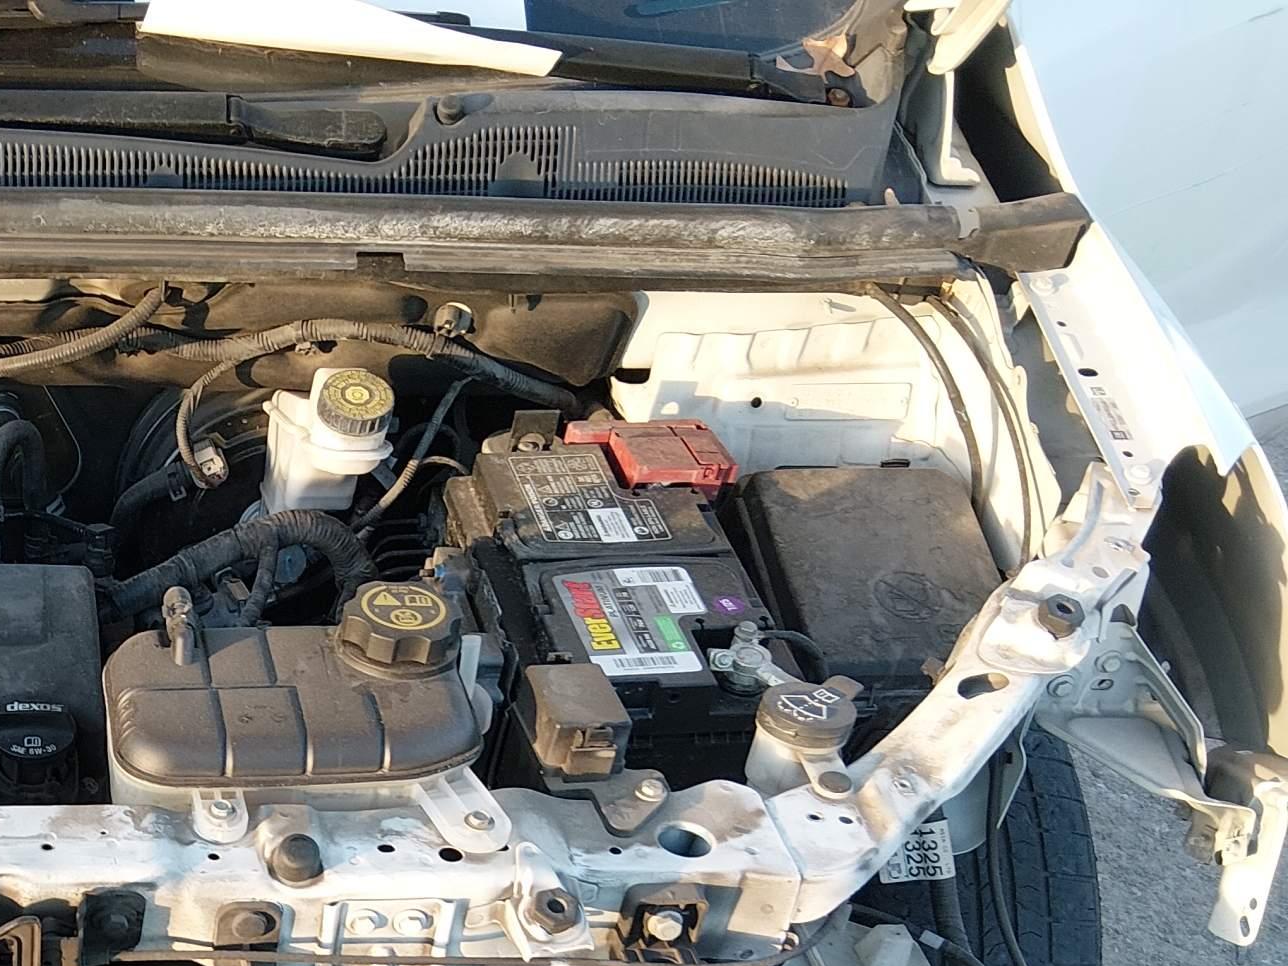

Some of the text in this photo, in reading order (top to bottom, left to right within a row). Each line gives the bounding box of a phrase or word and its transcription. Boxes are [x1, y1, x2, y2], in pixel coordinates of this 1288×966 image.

[561, 580, 622, 650] EverStart
[6, 701, 65, 712] dexos
[921, 828, 943, 877] 1325
